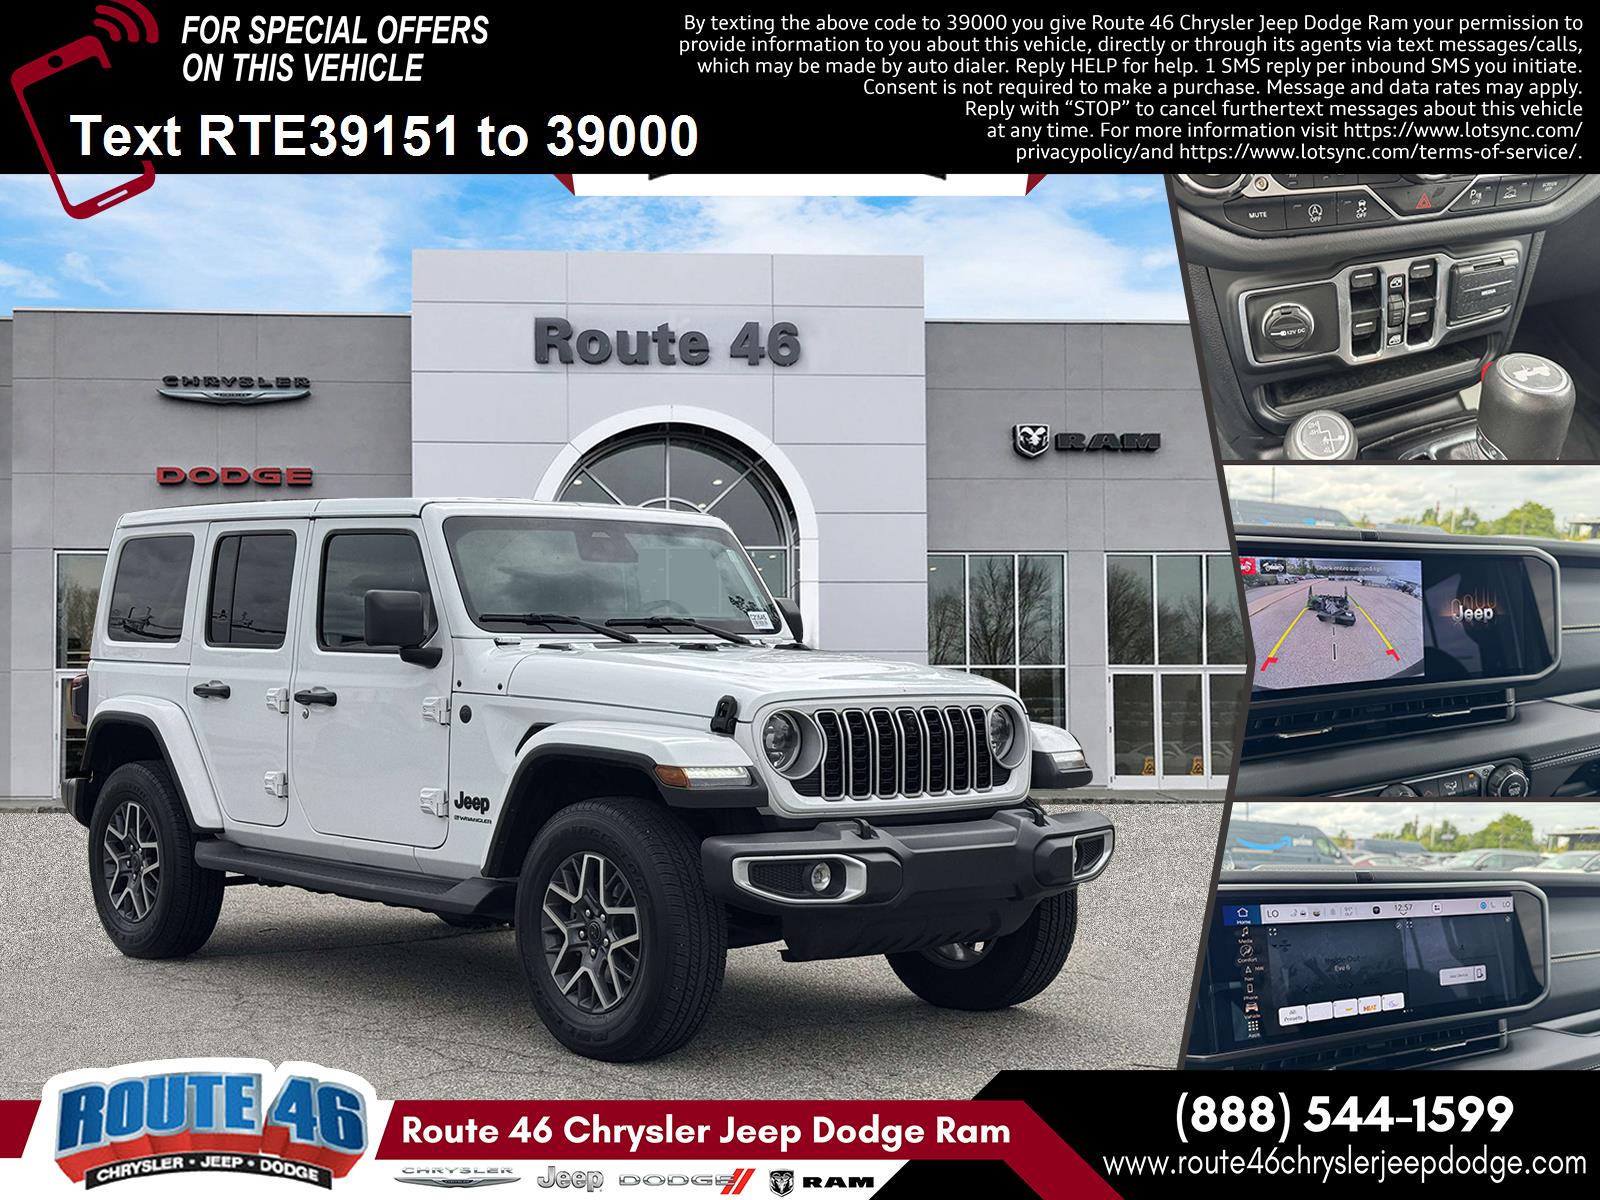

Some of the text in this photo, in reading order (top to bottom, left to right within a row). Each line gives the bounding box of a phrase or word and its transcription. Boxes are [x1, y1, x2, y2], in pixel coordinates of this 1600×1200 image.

[1248, 211, 1268, 219] MUTE
[534, 317, 802, 368] Route 46
[162, 375, 312, 389] CHRYSLER
[1055, 433, 1161, 452] RAM
[156, 466, 313, 486] DODGE
[1452, 604, 1494, 623] Jeep
[454, 791, 490, 815] Jeep
[1266, 909, 1279, 918] LO
[1394, 904, 1413, 912] 12:57
